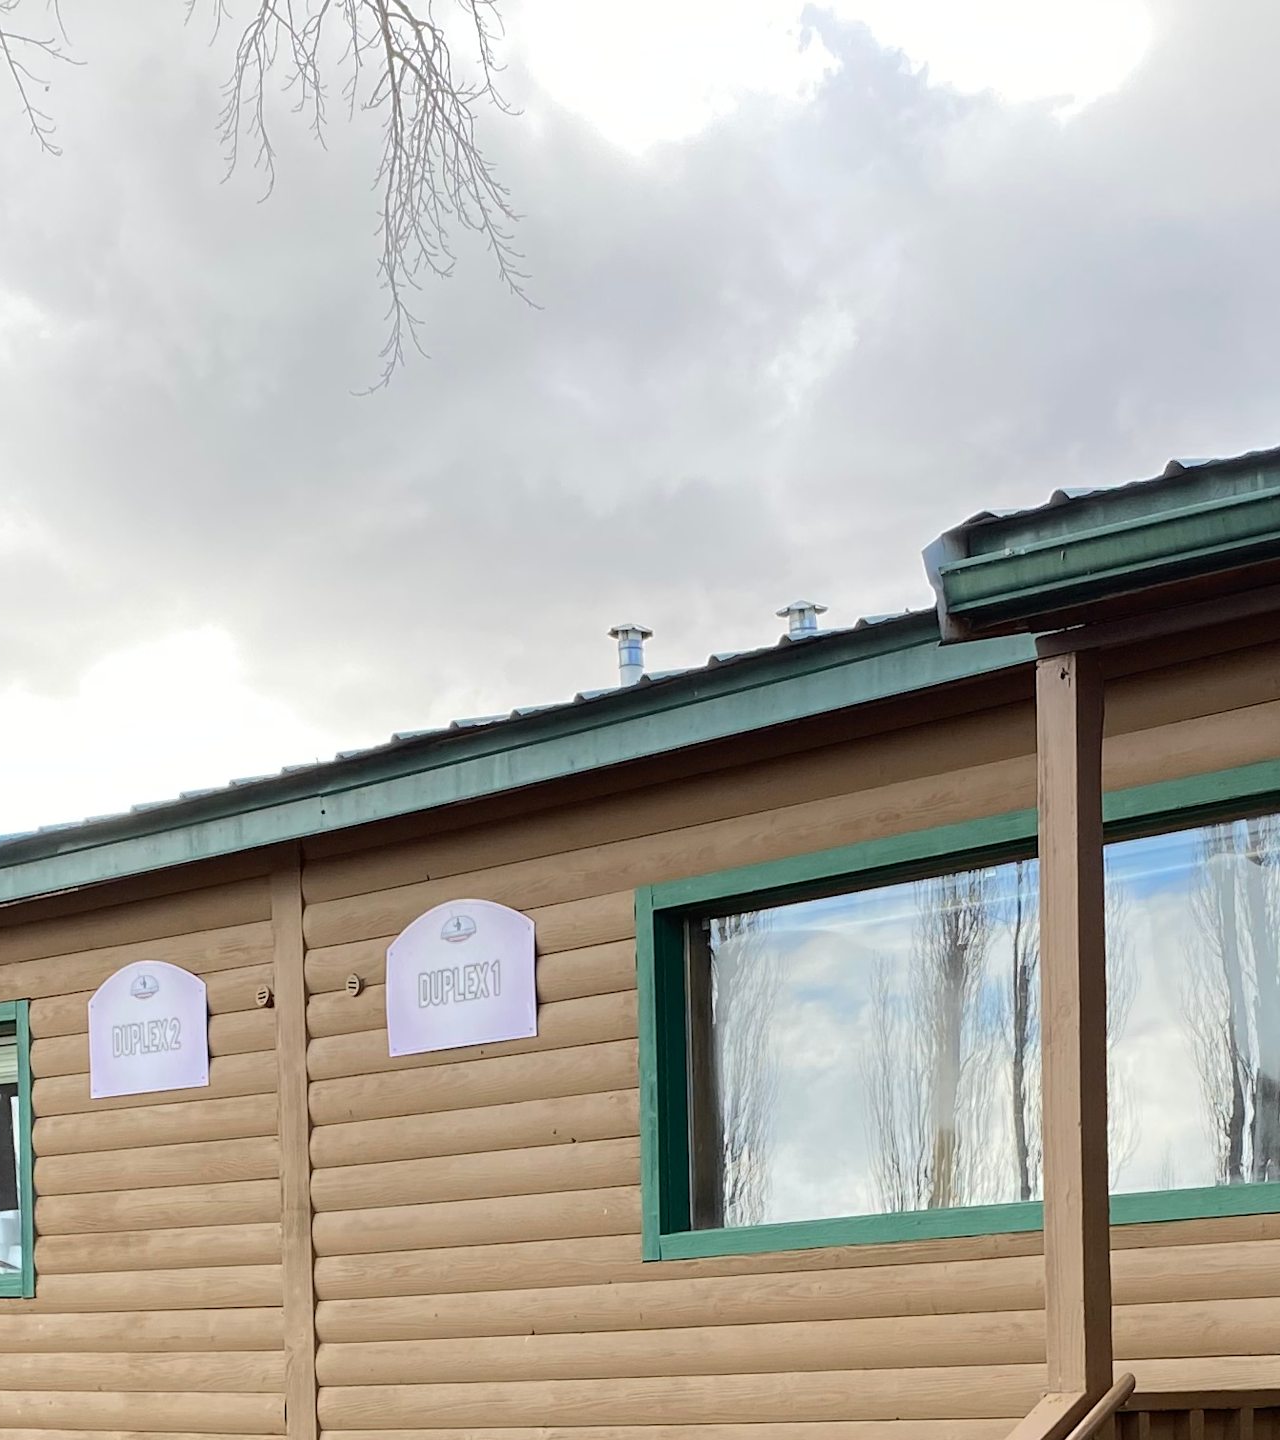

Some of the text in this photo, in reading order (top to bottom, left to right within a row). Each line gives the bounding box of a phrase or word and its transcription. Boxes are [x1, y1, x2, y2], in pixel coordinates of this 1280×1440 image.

[418, 959, 501, 1008] DUPLEX 1
[112, 1017, 182, 1059] DUPLEX 2
